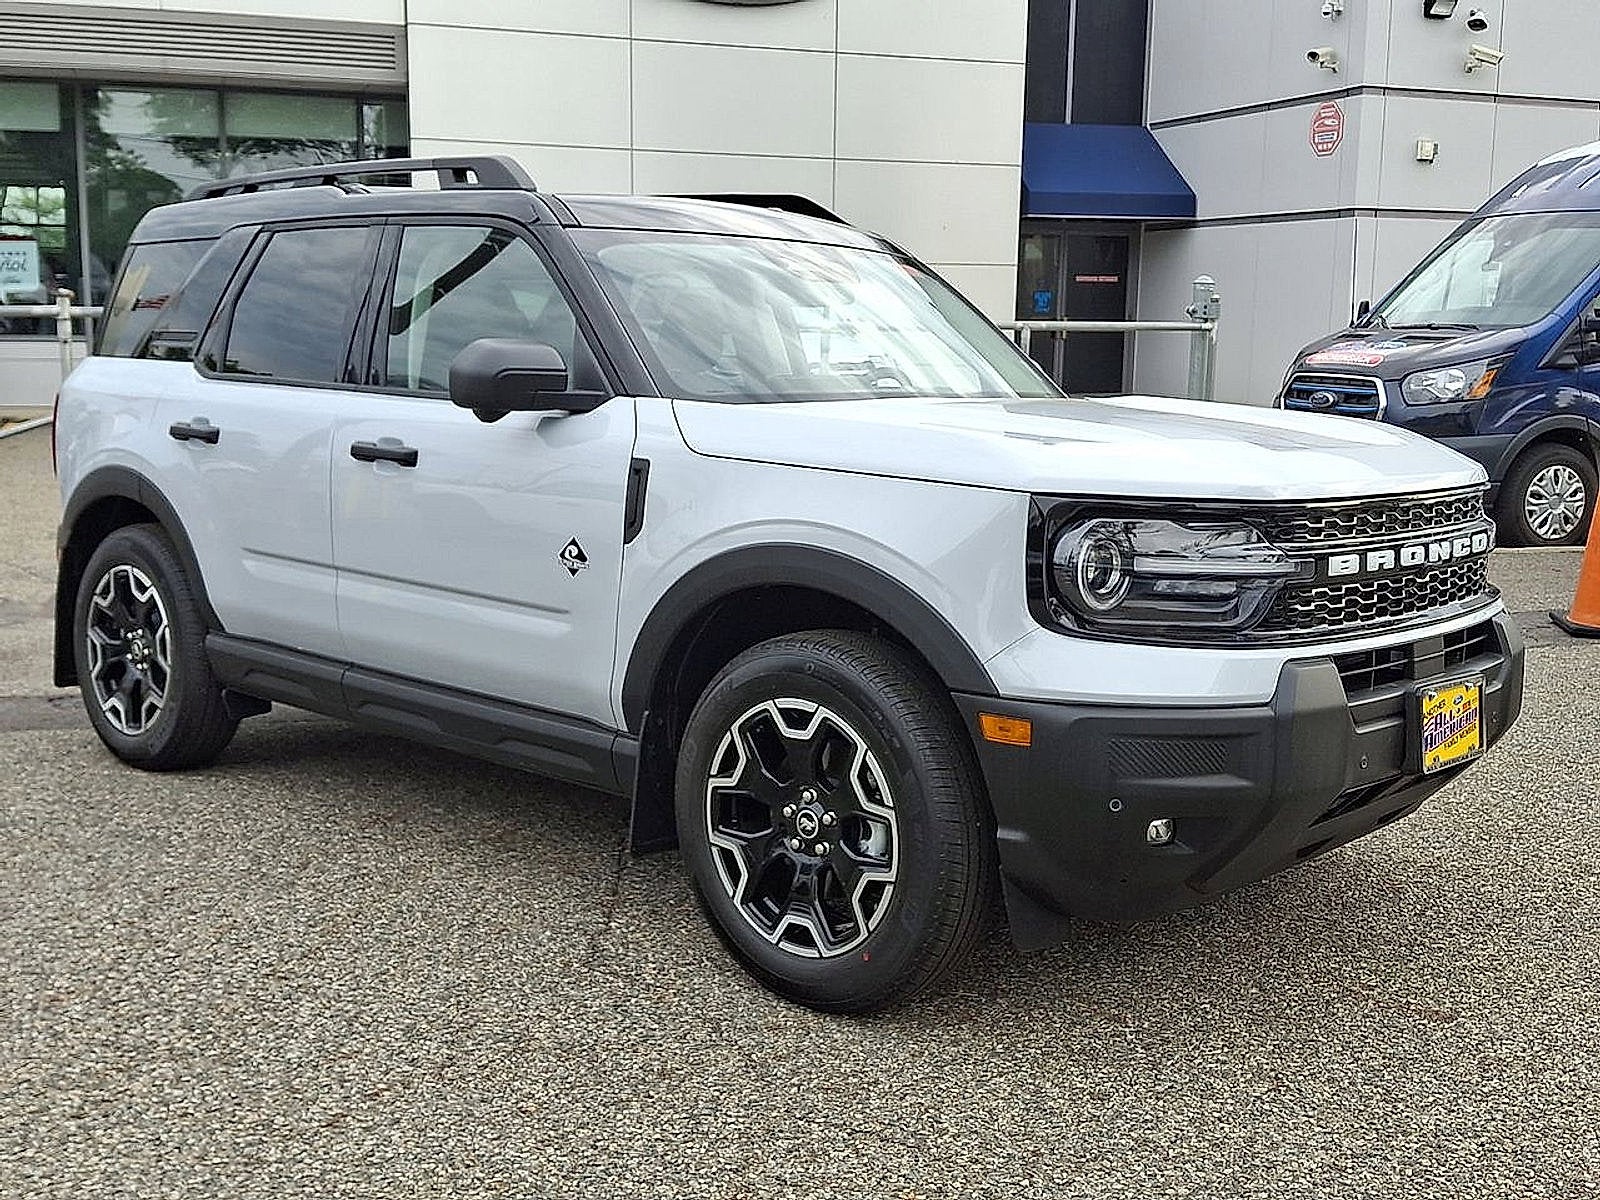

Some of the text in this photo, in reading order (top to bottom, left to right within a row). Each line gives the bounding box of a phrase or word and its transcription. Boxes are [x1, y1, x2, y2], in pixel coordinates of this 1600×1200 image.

[1327, 532, 1489, 577] BRONCO
[1423, 707, 1478, 751] AMERICAN
[1434, 709, 1456, 732] ALL
